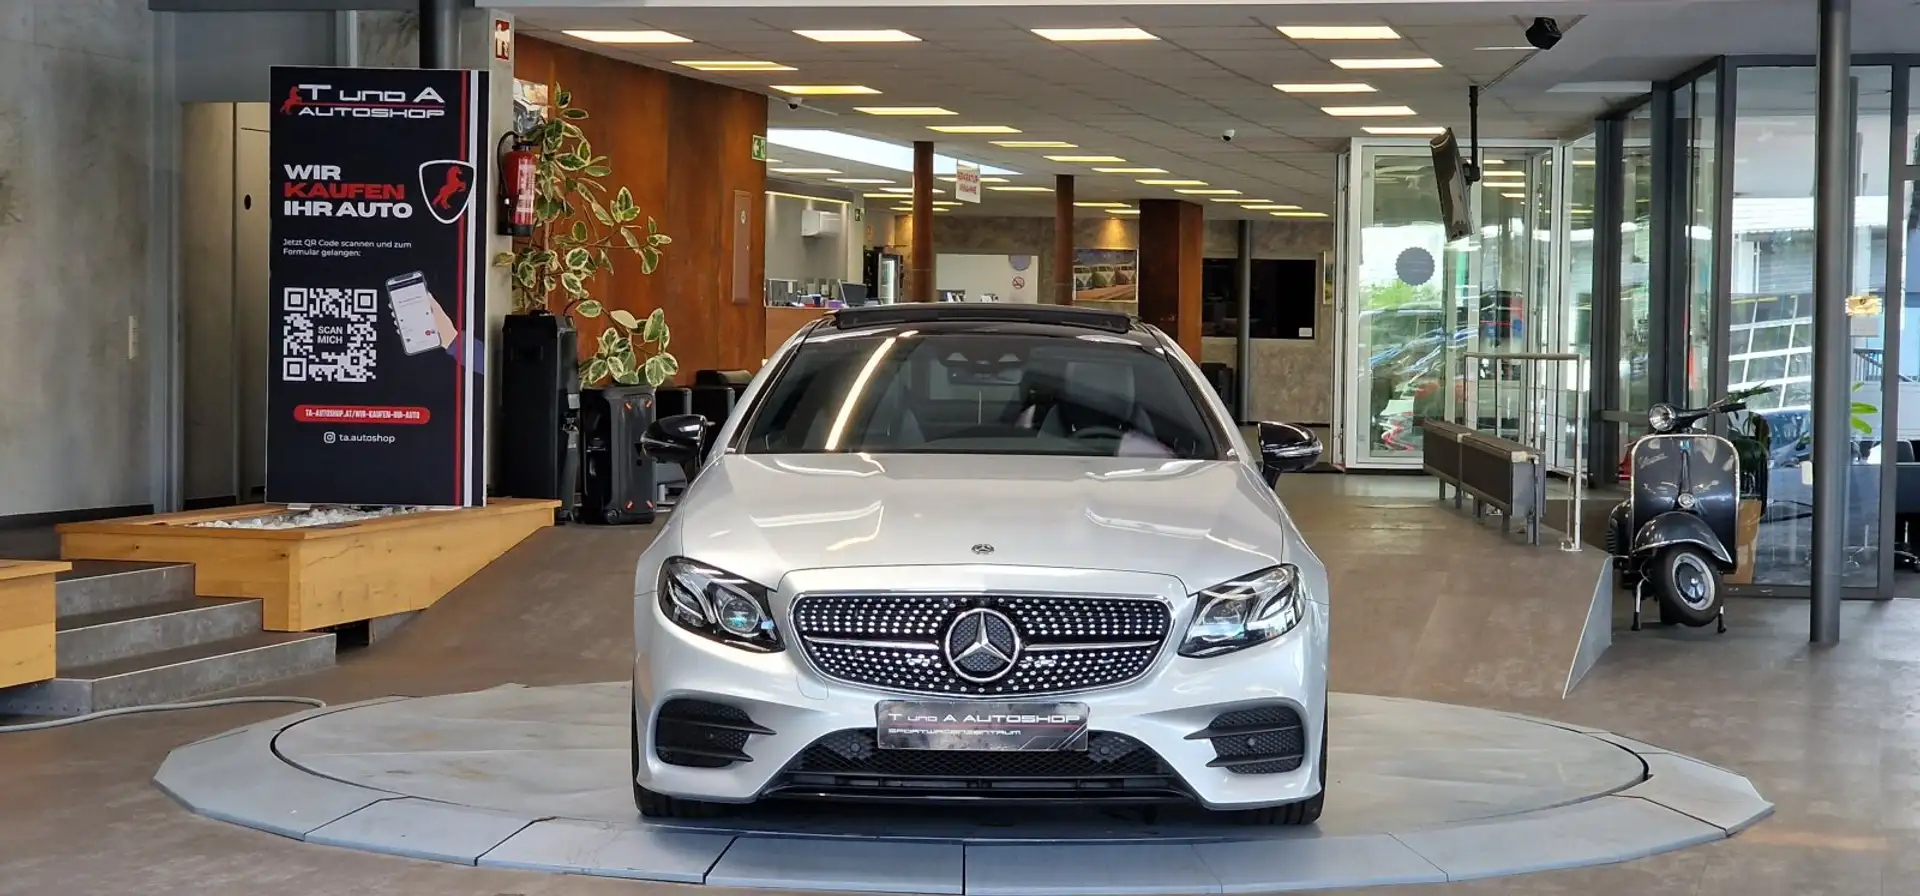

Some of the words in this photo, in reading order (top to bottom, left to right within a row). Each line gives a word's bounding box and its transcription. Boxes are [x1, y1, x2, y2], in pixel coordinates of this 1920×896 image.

[298, 84, 332, 101] T
[413, 86, 446, 103] A
[298, 106, 445, 118] AUTOSHOP
[284, 164, 341, 180] WIR
[284, 182, 405, 200] KAUFEN
[284, 200, 333, 217] IHR
[335, 201, 413, 219] AUTO
[282, 238, 303, 247] Jetzt
[304, 238, 317, 248] QR
[318, 238, 340, 247] Code
[341, 240, 375, 248] scannen
[376, 240, 393, 249] und
[394, 241, 412, 249] zum
[283, 247, 320, 256] Formular
[317, 325, 343, 335] SCAN
[317, 335, 343, 344] MICH
[338, 433, 396, 444] ta.autoshop
[888, 713, 903, 722] T
[943, 713, 957, 723] A
[962, 713, 1081, 724] AUTOSHOP
